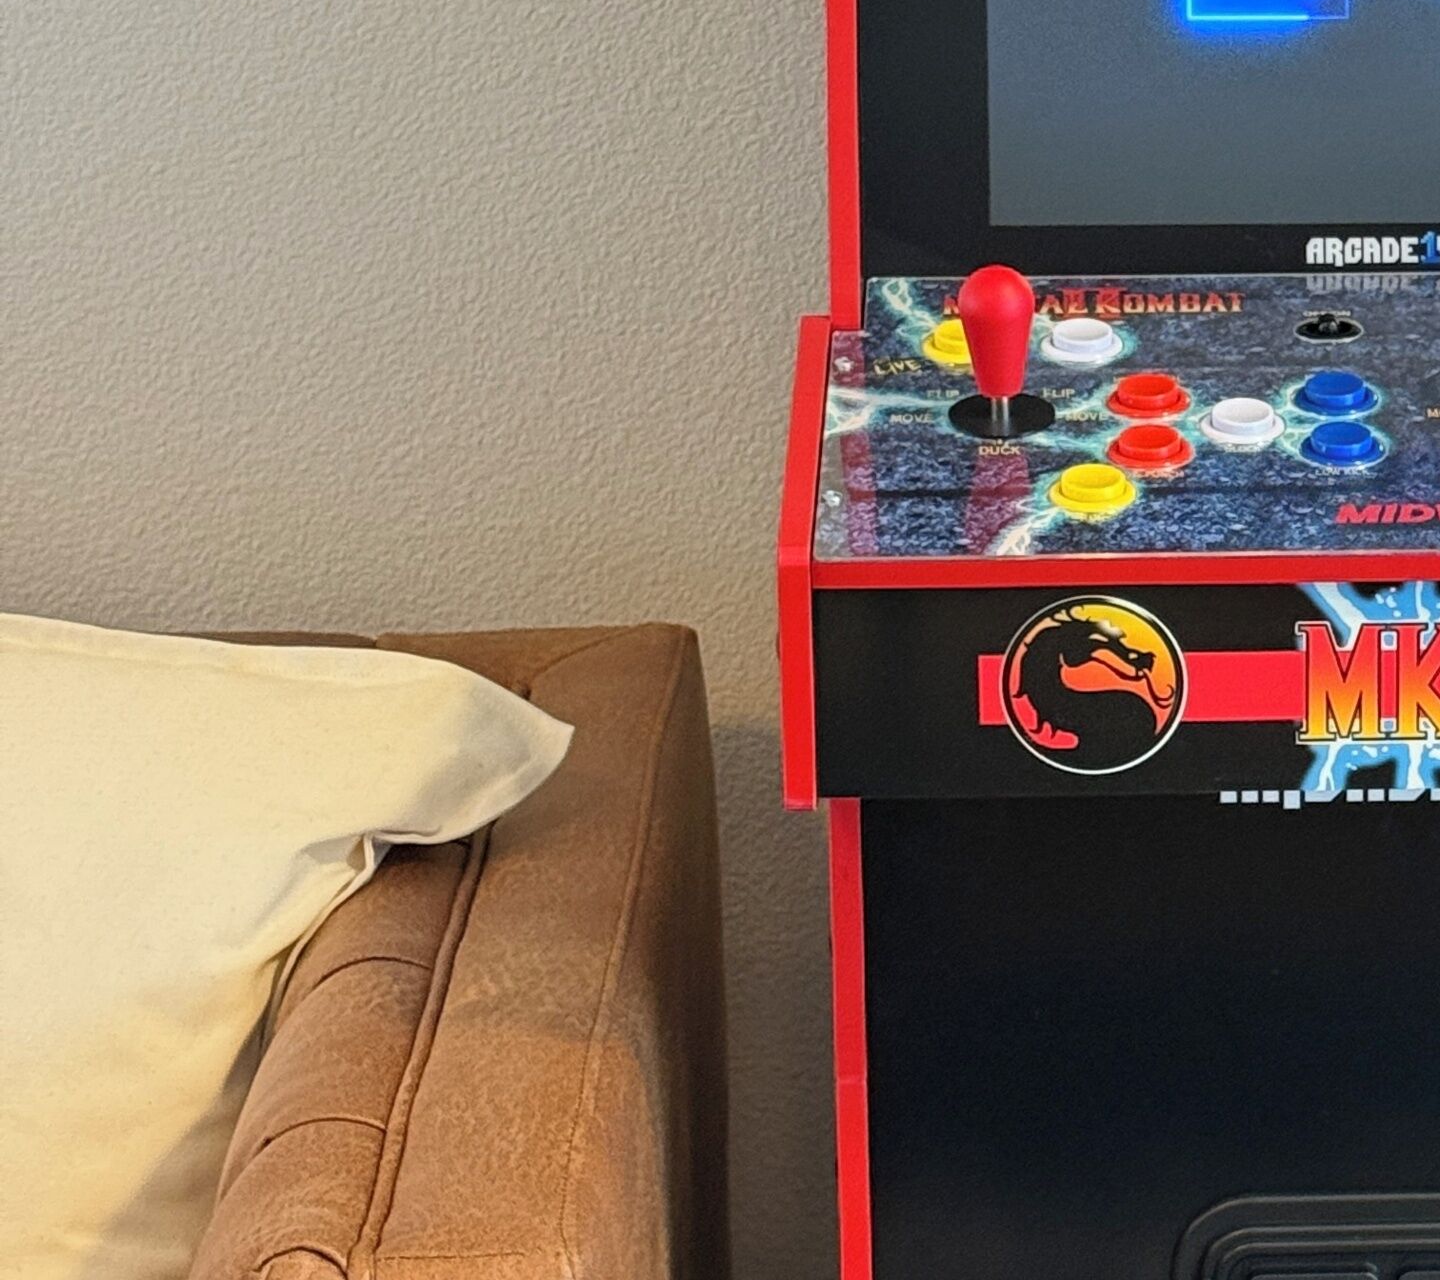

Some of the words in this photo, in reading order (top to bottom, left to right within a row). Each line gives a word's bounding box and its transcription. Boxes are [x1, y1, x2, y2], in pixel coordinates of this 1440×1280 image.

[1043, 388, 1075, 399] FLIP
[889, 413, 933, 423] MOVE
[978, 445, 1022, 456] DUCK
